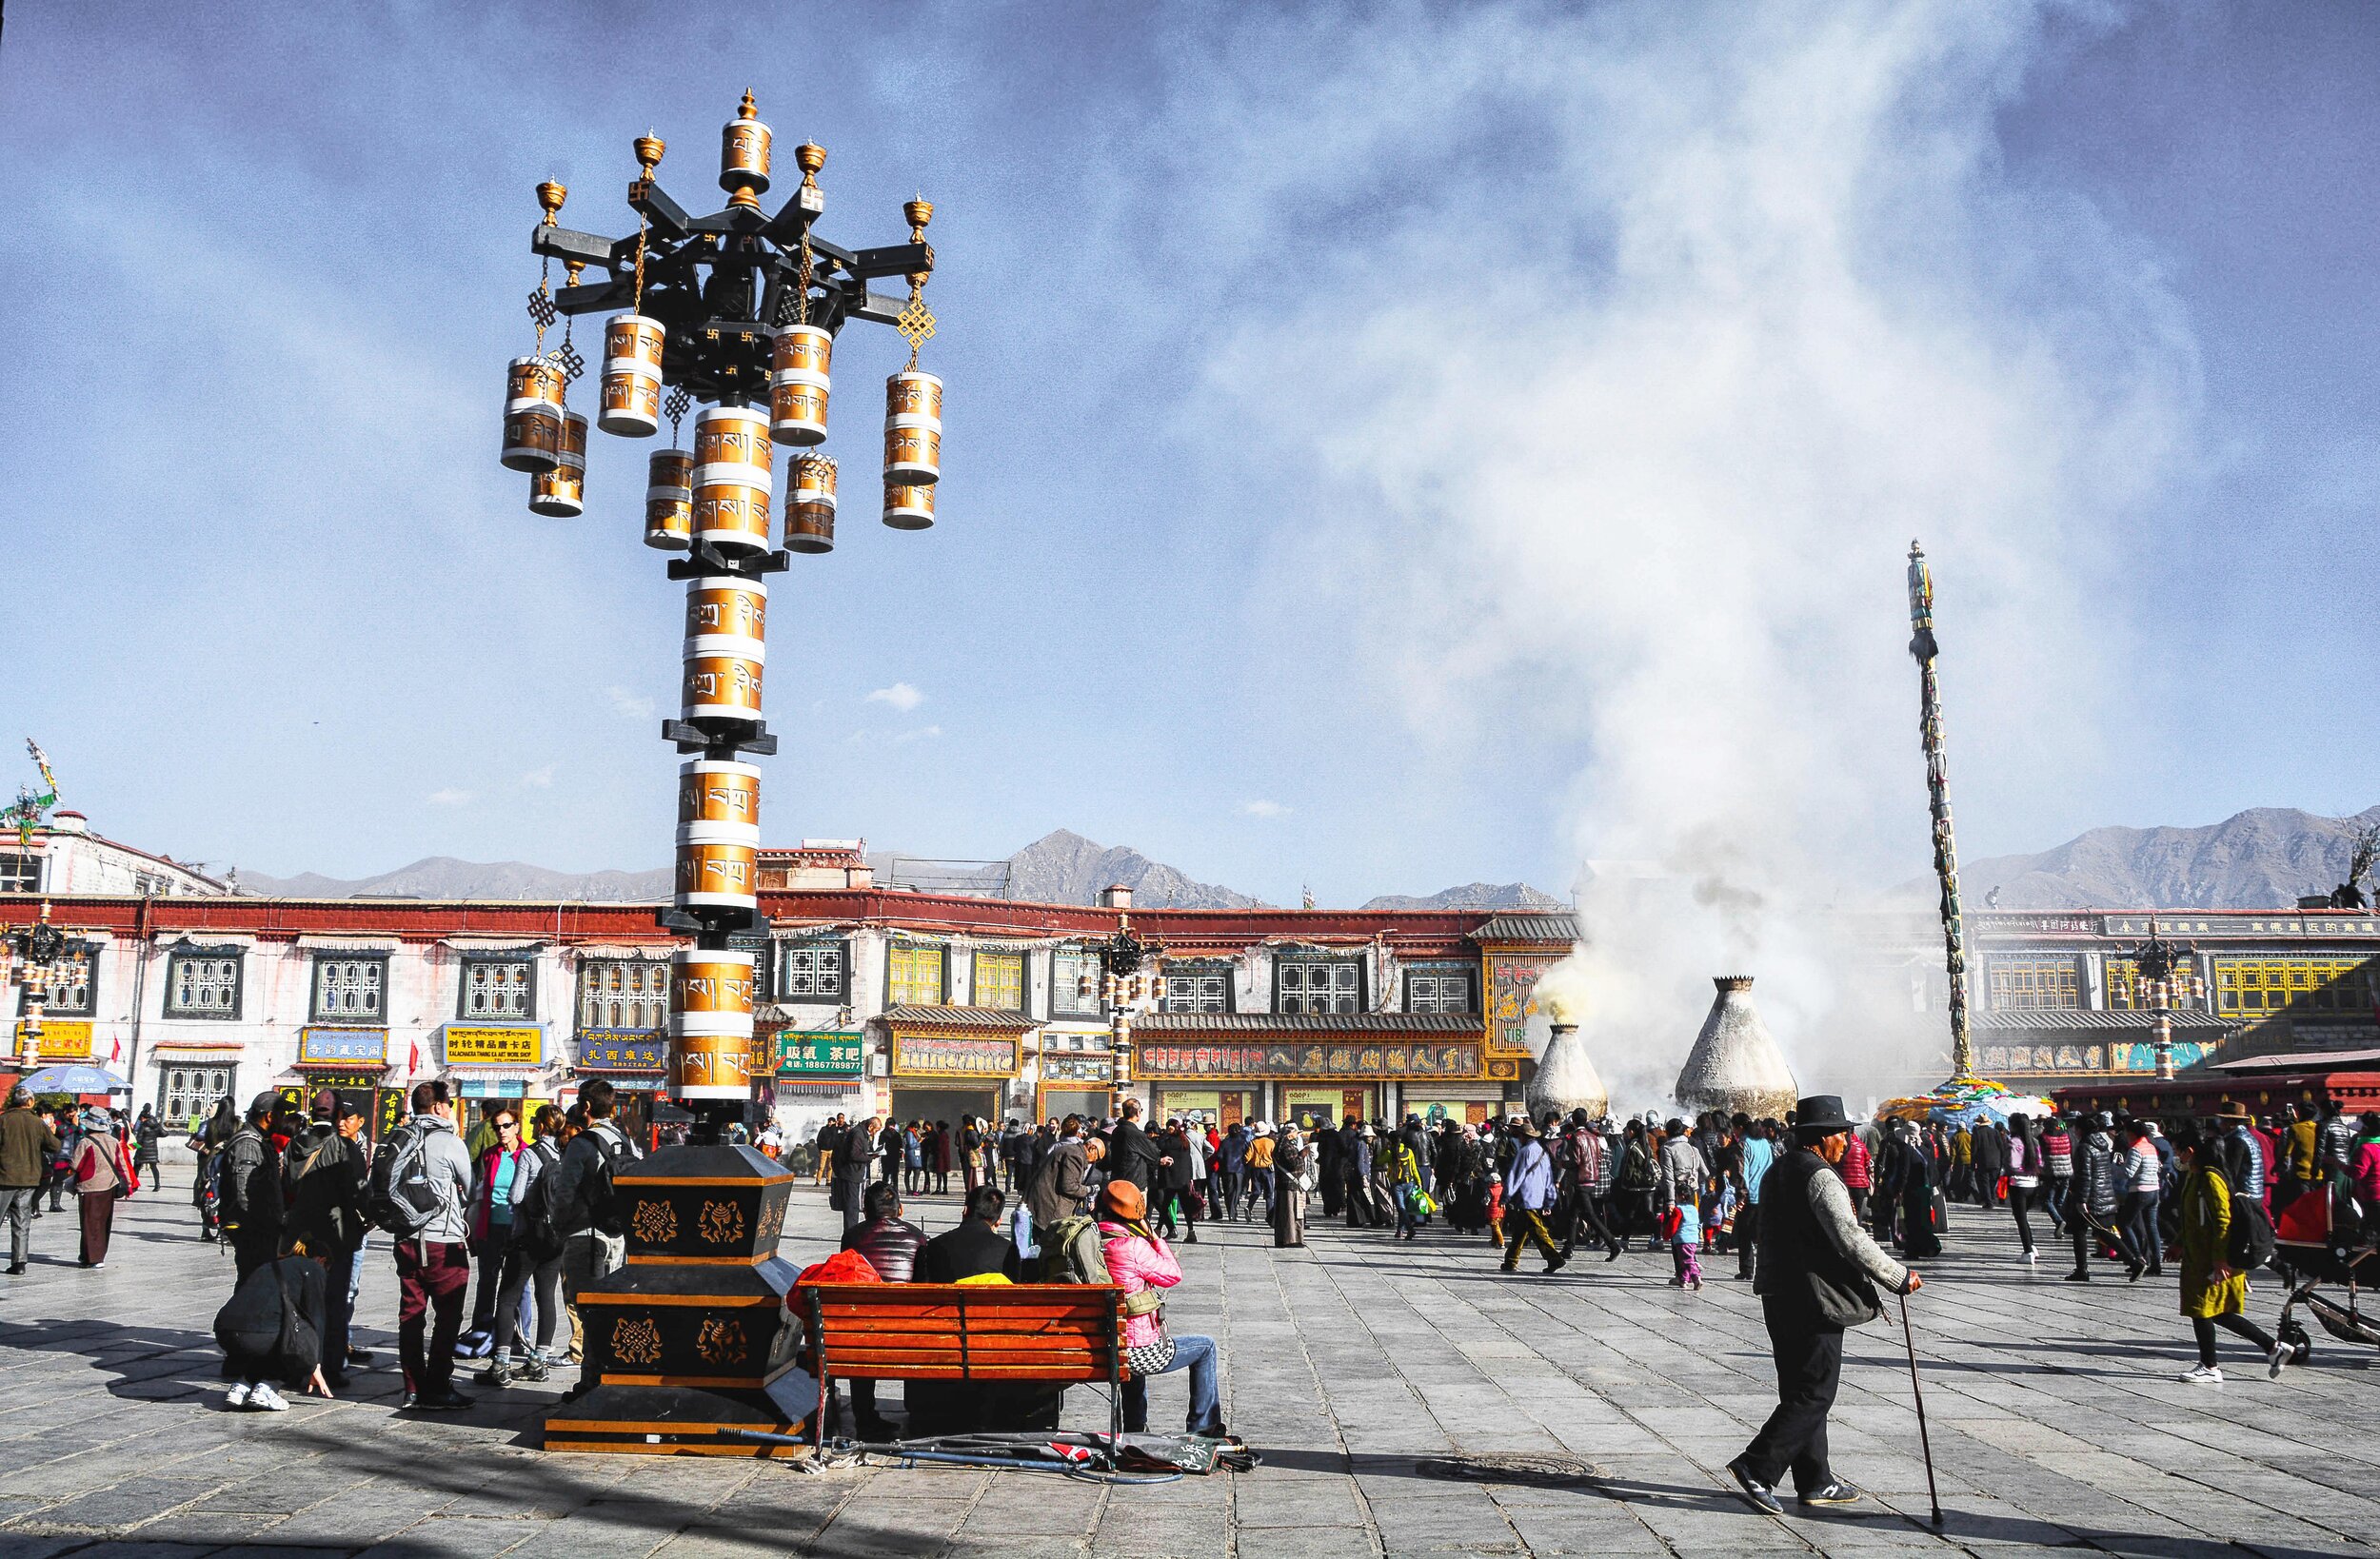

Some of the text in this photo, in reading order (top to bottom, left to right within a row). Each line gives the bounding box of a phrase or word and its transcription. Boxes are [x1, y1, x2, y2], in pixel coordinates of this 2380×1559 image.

[448, 1039, 531, 1049] 时轮精品唐卡店
[308, 1044, 381, 1056] 奇韵藏宝阁
[588, 1050, 655, 1061] 扎西雍达
[786, 1046, 859, 1060] 吸氧 茶吧
